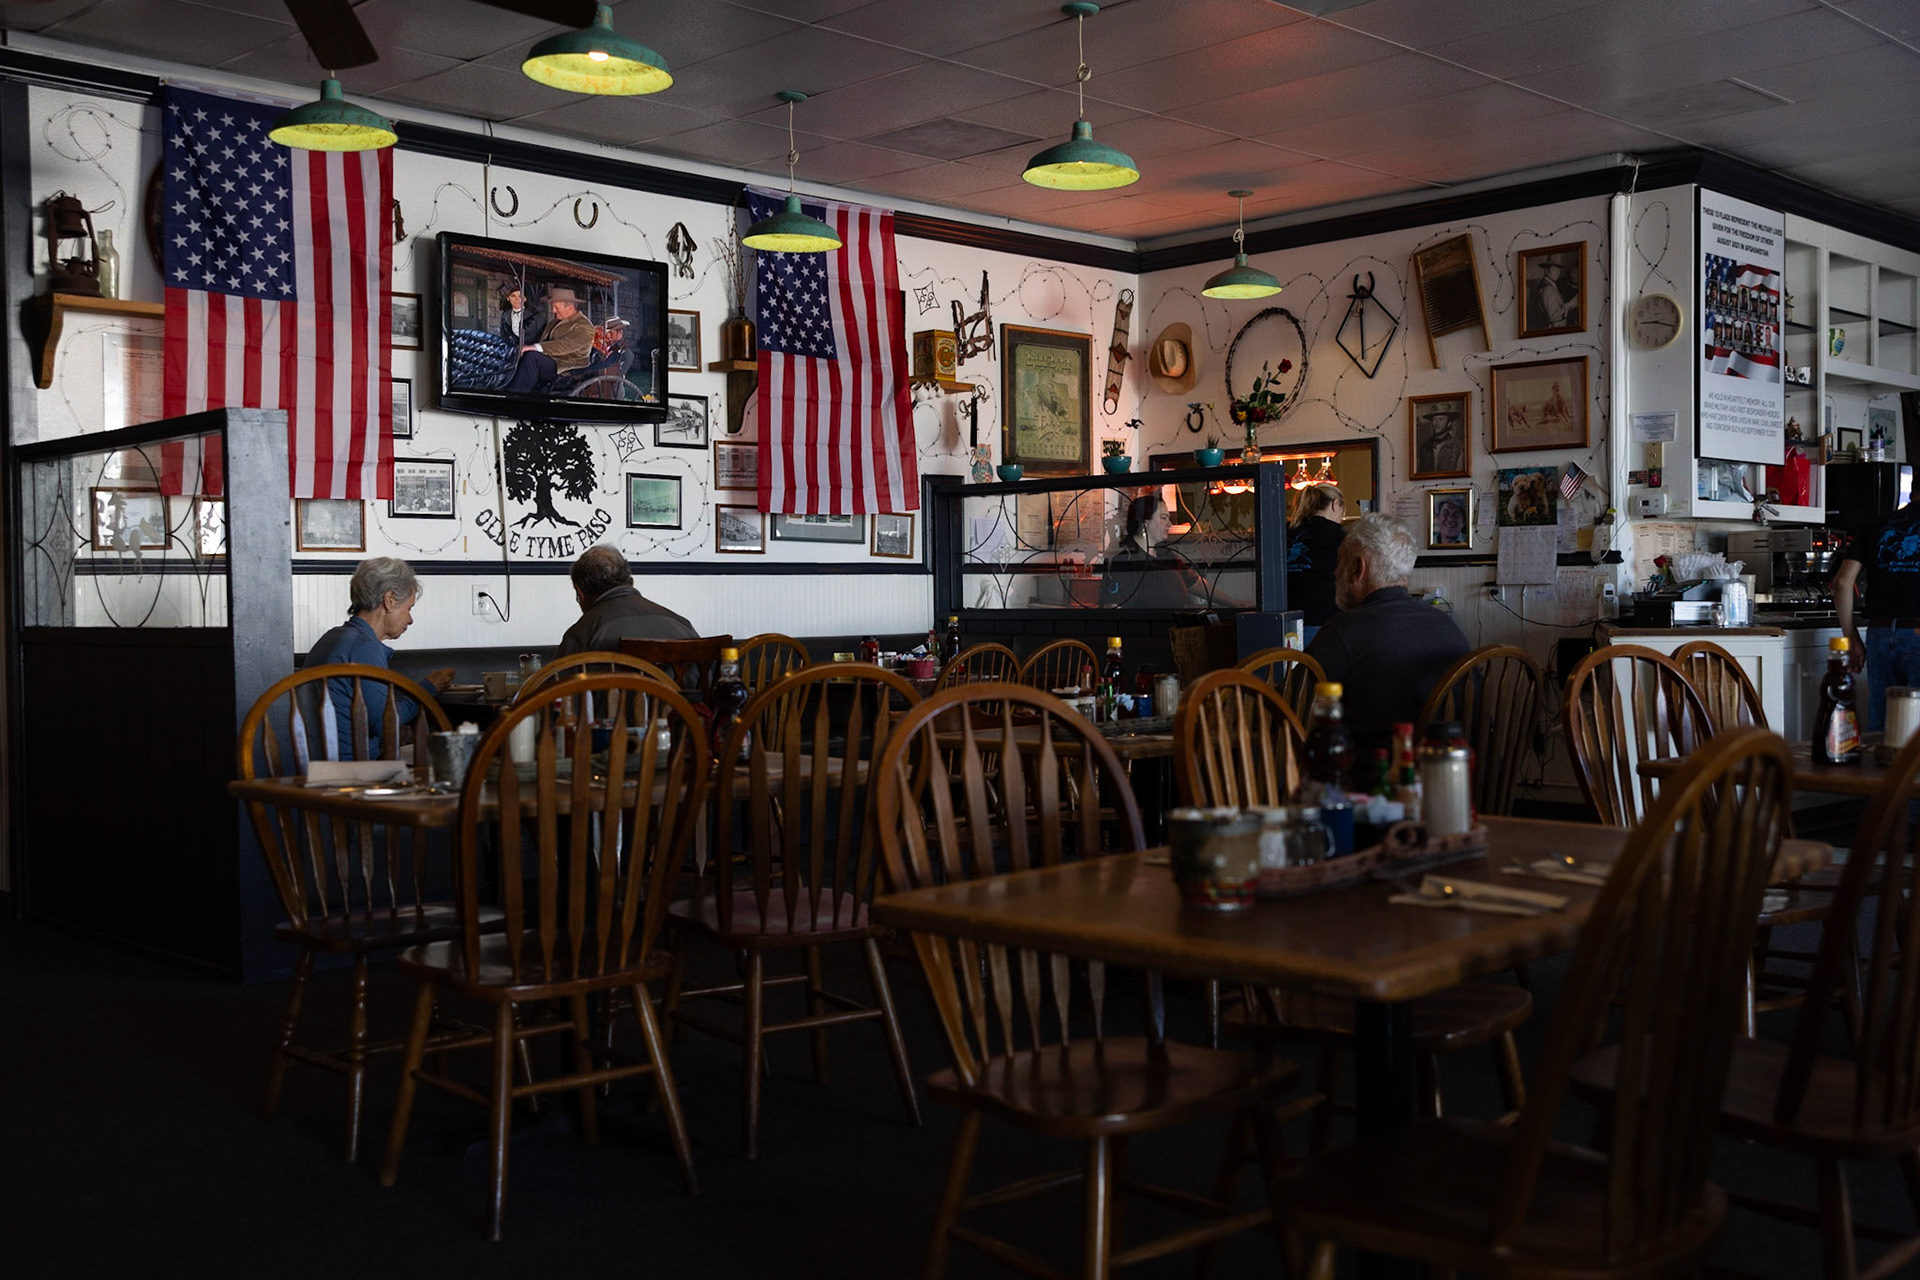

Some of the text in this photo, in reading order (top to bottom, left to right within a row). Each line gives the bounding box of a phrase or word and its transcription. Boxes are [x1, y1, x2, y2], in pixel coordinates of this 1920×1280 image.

[475, 508, 612, 559] OLDE TYME PASO
